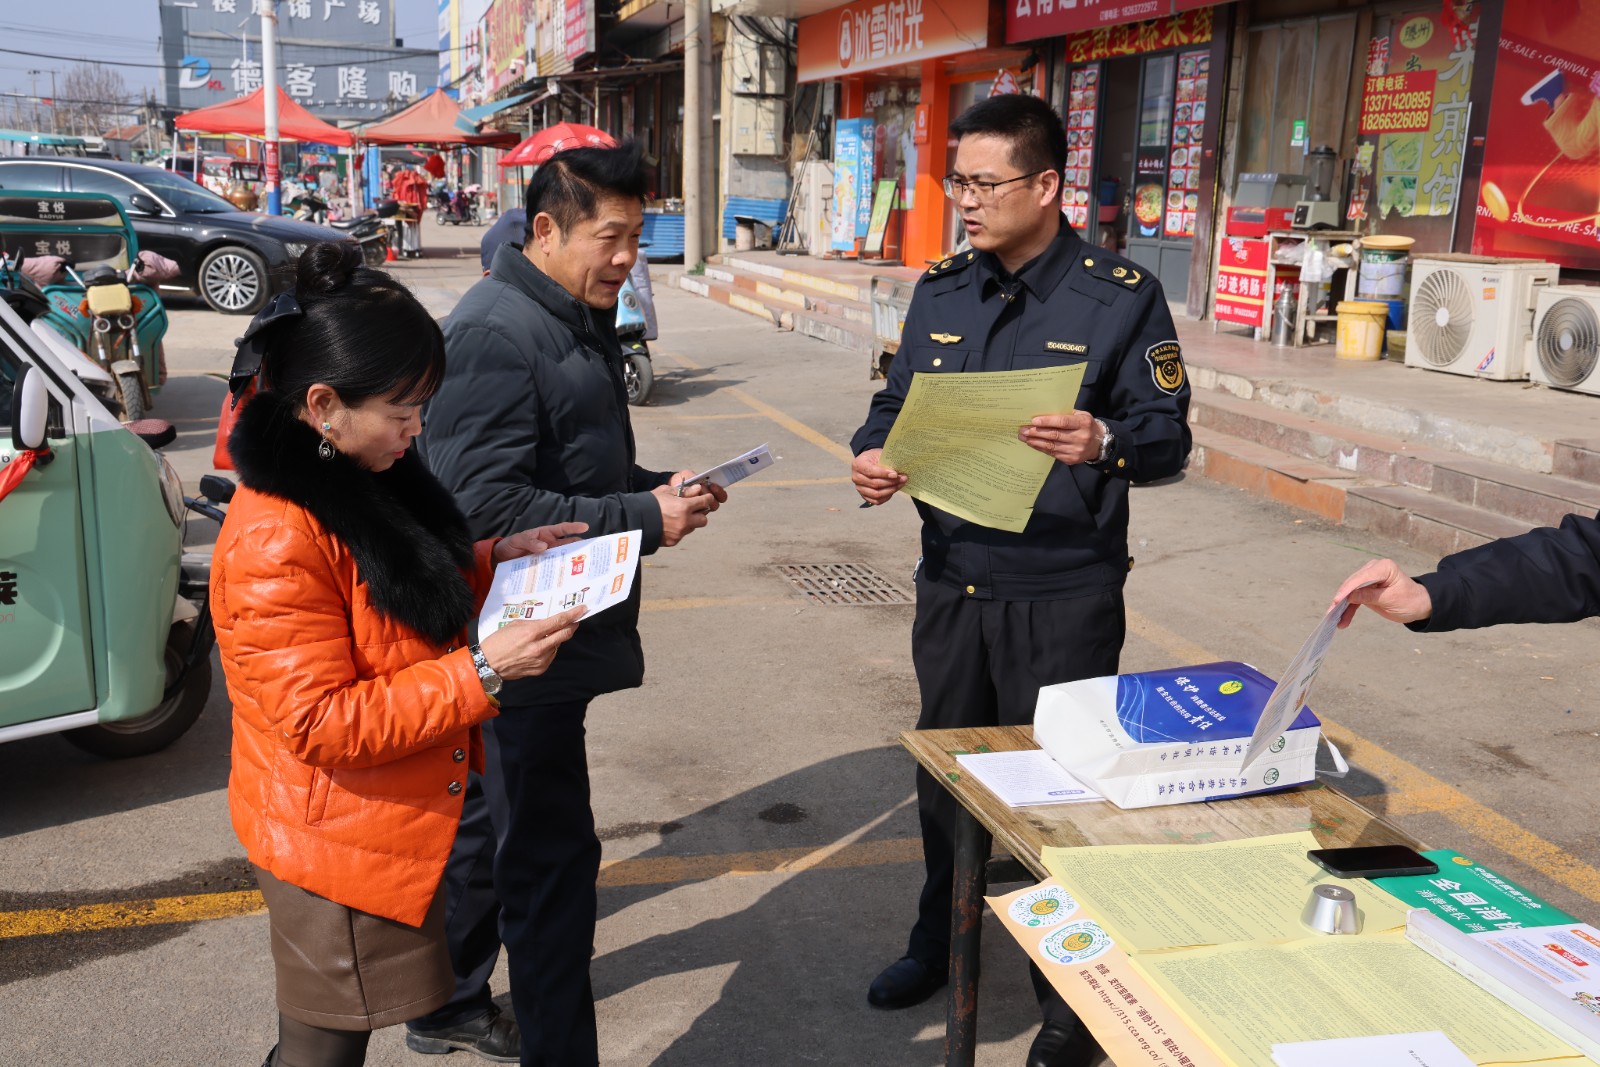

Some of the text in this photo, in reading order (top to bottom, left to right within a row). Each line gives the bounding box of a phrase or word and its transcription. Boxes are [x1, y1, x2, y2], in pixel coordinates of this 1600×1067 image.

[855, 0, 924, 63] 冰雪时光
[1542, 54, 1590, 78] CARNIVAL
[1366, 75, 1408, 92] 订餐电话:
[1364, 91, 1432, 112] 13371420895
[1362, 110, 1429, 130] 18266326089
[37, 200, 66, 214] 宝悦
[35, 240, 72, 256] 宝悦
[1160, 742, 1250, 761] 建和谐文明社会
[1158, 777, 1248, 796] 维护消费者合法权益
